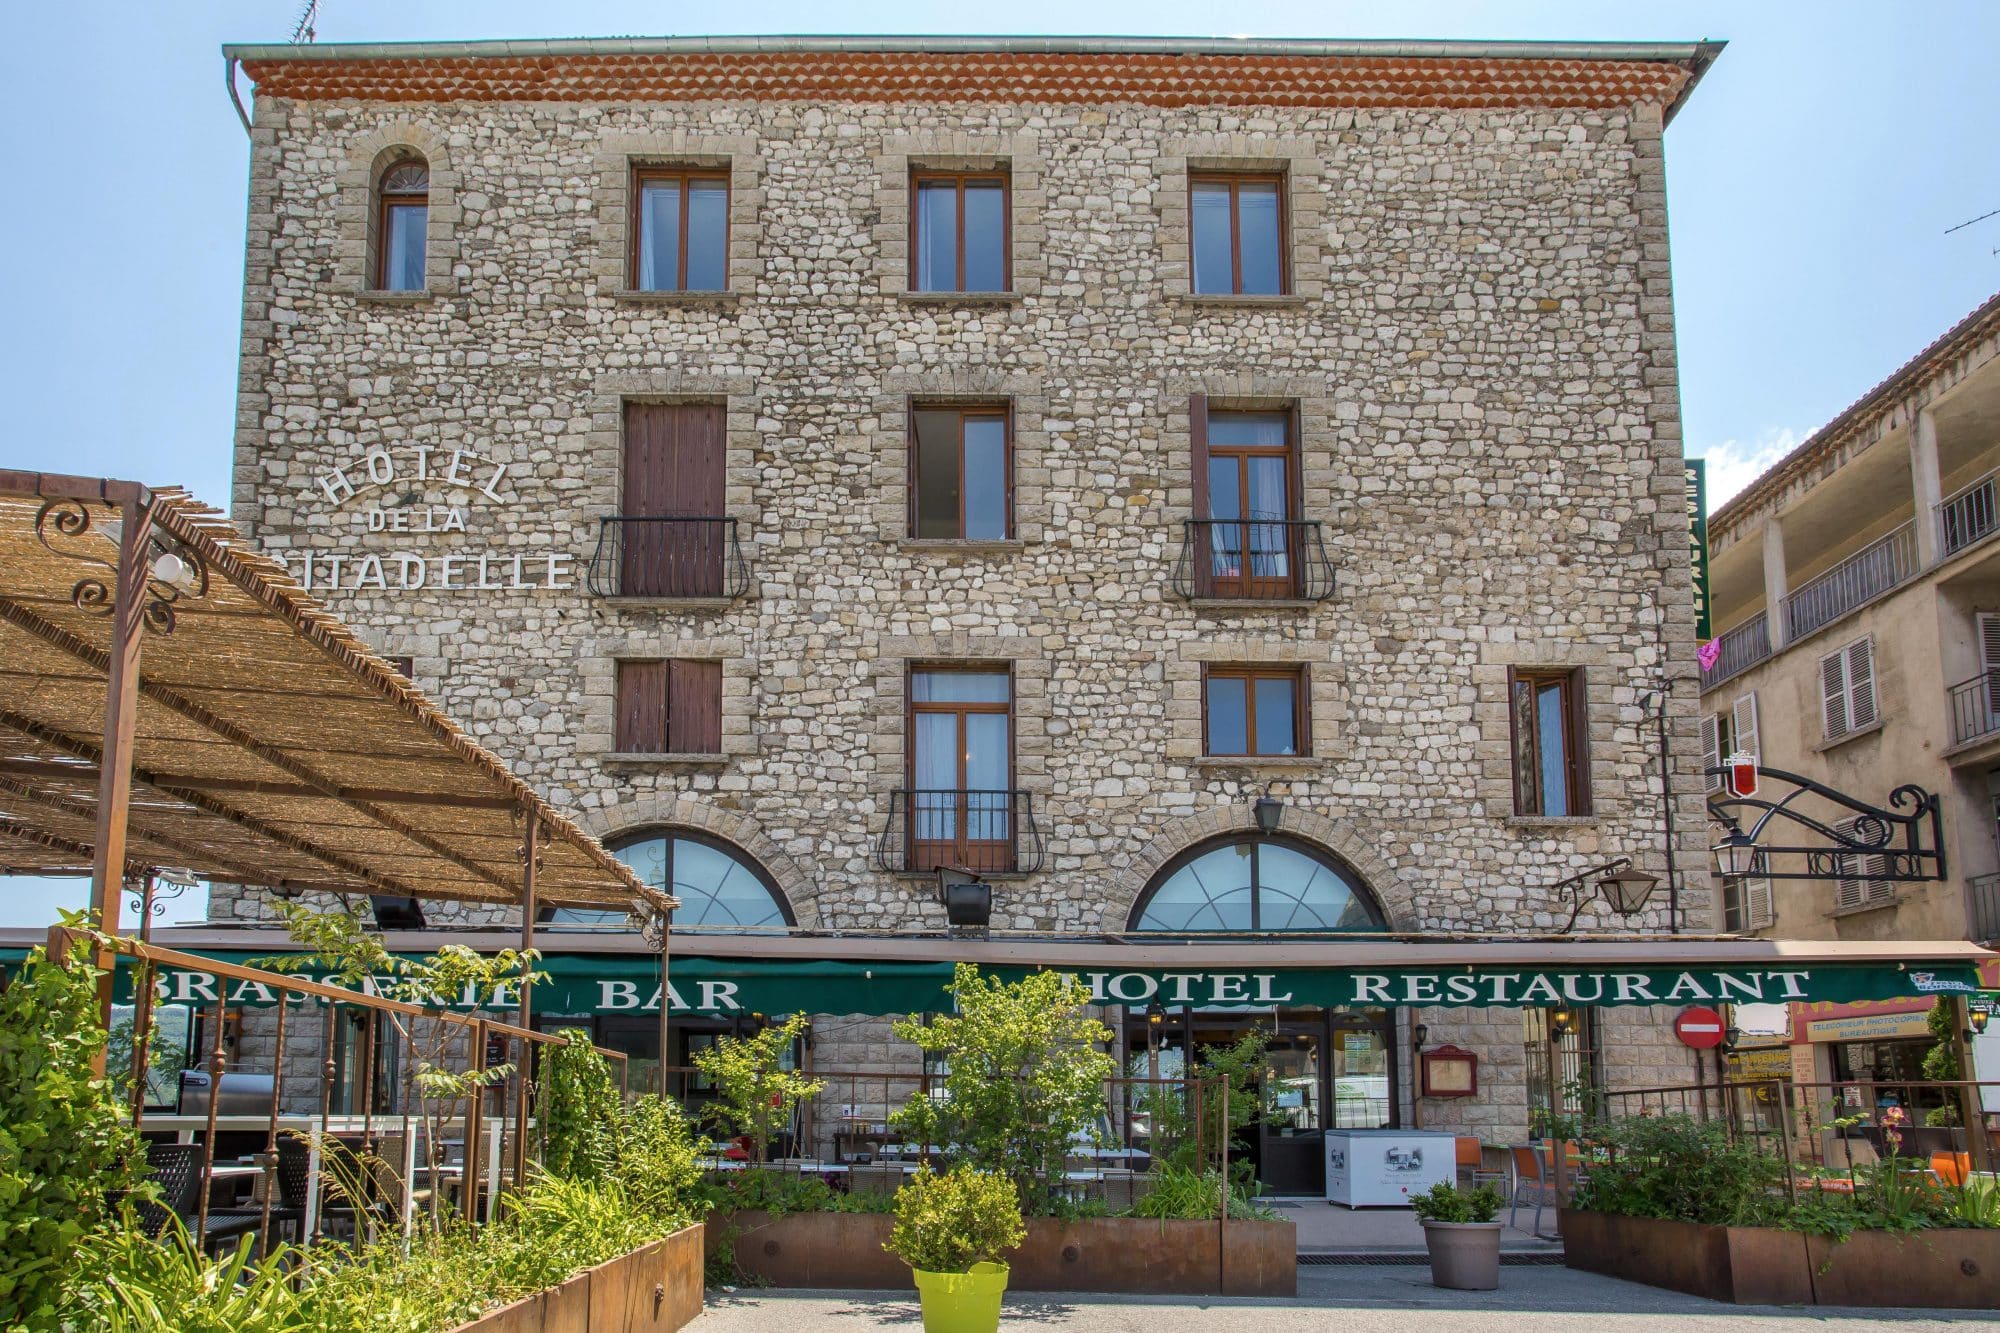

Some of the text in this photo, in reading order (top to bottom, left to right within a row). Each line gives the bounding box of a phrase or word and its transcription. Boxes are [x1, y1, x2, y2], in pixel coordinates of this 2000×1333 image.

[318, 445, 508, 506] HOTEL
[369, 508, 465, 532] DE LA
[595, 980, 745, 1010] BAR
[1058, 971, 1809, 1002] HOTEL RESTAURANT
